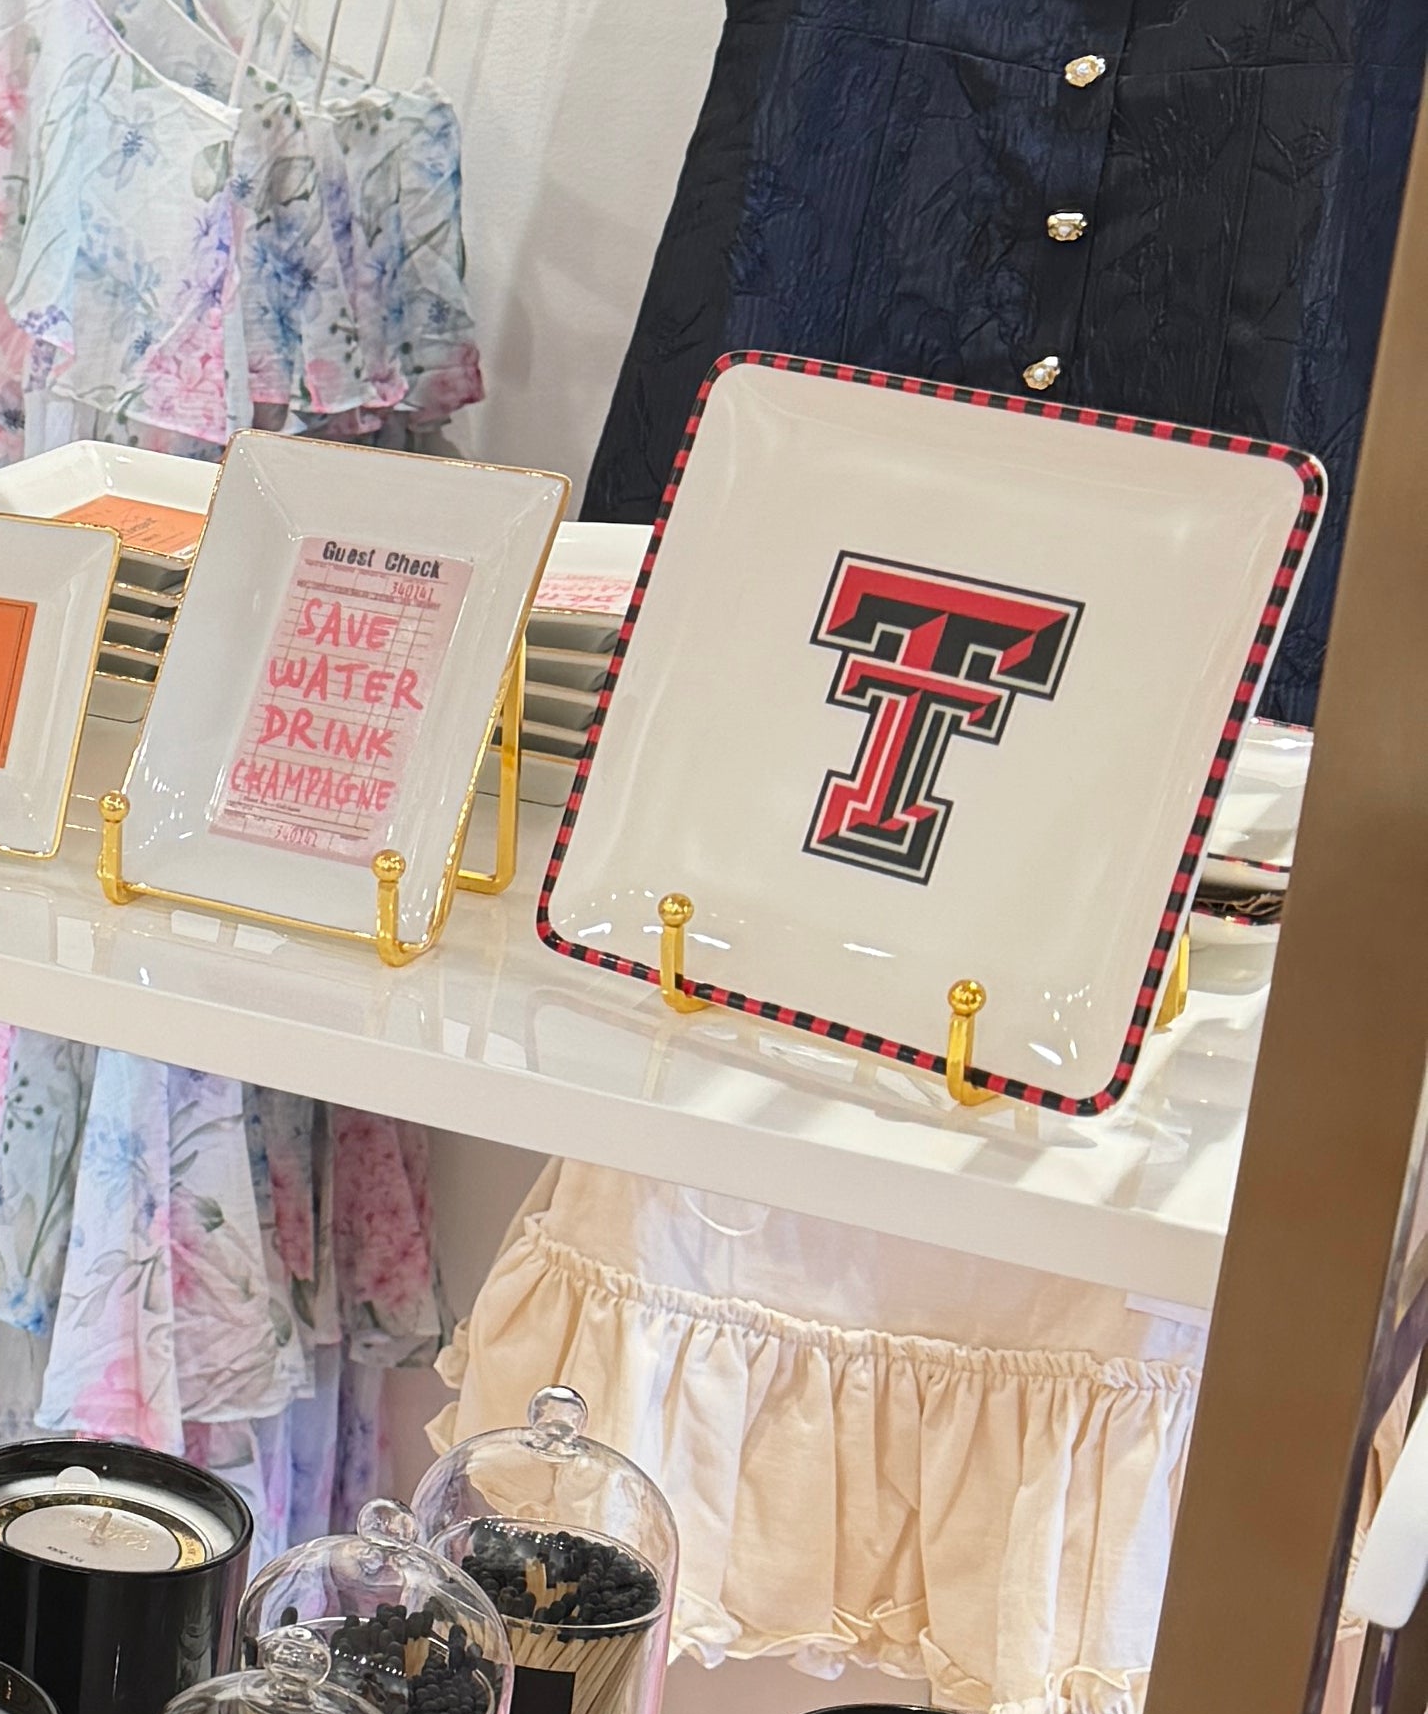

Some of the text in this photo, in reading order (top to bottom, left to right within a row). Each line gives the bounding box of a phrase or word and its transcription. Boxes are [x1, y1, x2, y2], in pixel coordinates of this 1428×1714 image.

[321, 540, 442, 581] Guest Check
[297, 597, 399, 652] SAVE
[268, 653, 425, 712] WATER
[257, 703, 396, 761] DRINK
[230, 757, 397, 813] CHAMPAGNE
